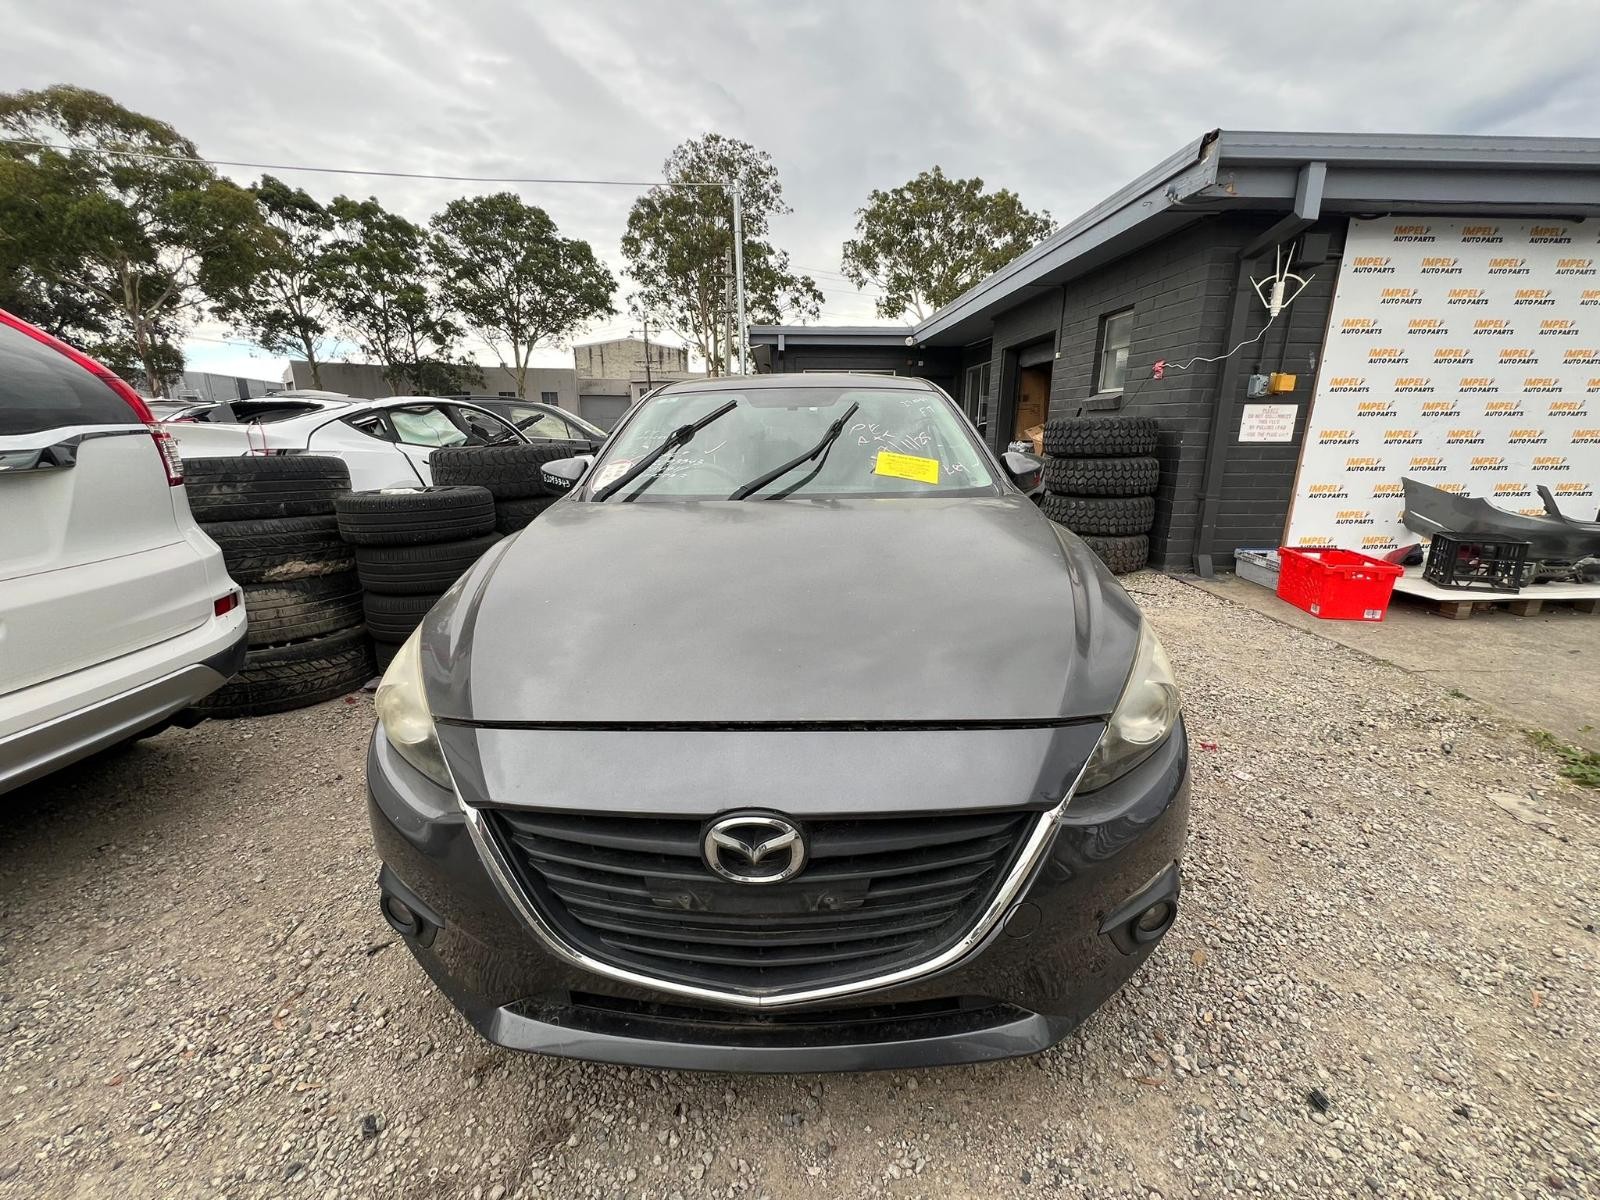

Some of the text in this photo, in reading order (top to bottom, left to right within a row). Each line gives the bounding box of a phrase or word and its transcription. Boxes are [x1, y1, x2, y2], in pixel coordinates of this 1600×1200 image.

[1394, 226, 1424, 235] IMPEL
[1462, 226, 1492, 235] IMPEL
[1530, 227, 1560, 236] IMPEL
[1354, 257, 1384, 266] IMPEL
[1421, 258, 1452, 267] IMPEL
[1489, 258, 1519, 267] IMPEL
[1556, 259, 1586, 268] IMPEL
[1381, 288, 1412, 297] IMPEL
[1448, 289, 1478, 298] IMPEL
[1515, 290, 1544, 299] IMPEL
[1342, 319, 1372, 328] IMPEL
[1409, 319, 1438, 328] IMPEL
[1474, 320, 1503, 329] IMPEL
[1540, 320, 1569, 329] IMPEL
[1369, 348, 1398, 357] IMPEL
[1434, 349, 1463, 358] IMPEL
[1500, 349, 1528, 358] IMPEL
[1564, 349, 1593, 358] IMPEL
[1330, 378, 1359, 387] IMPEL
[1396, 378, 1424, 387] IMPEL
[1460, 378, 1488, 387] IMPEL
[1524, 378, 1552, 387] IMPEL
[1358, 402, 1387, 411] IMPEL
[1422, 401, 1450, 410] IMPEL
[1486, 401, 1514, 410] IMPEL
[1549, 401, 1577, 410] IMPEL
[1320, 429, 1349, 438] IMPEL
[1385, 429, 1412, 438] IMPEL
[1447, 429, 1475, 438] IMPEL
[1509, 429, 1537, 438] IMPEL
[1571, 429, 1600, 438] IMPE
[1347, 457, 1375, 466] IMPEL
[1410, 457, 1437, 466] IMPEL
[1471, 456, 1498, 465] IMPEL
[1532, 456, 1560, 465] IMPEL
[1309, 484, 1338, 493] IMPEL
[1374, 484, 1402, 493] IMPEL
[1494, 482, 1521, 491] IMPEL
[1555, 482, 1583, 491] IMPEL
[1336, 510, 1364, 519] IMPEL
[1300, 536, 1327, 545] IMPEL
[1363, 535, 1389, 544] IMPEL
